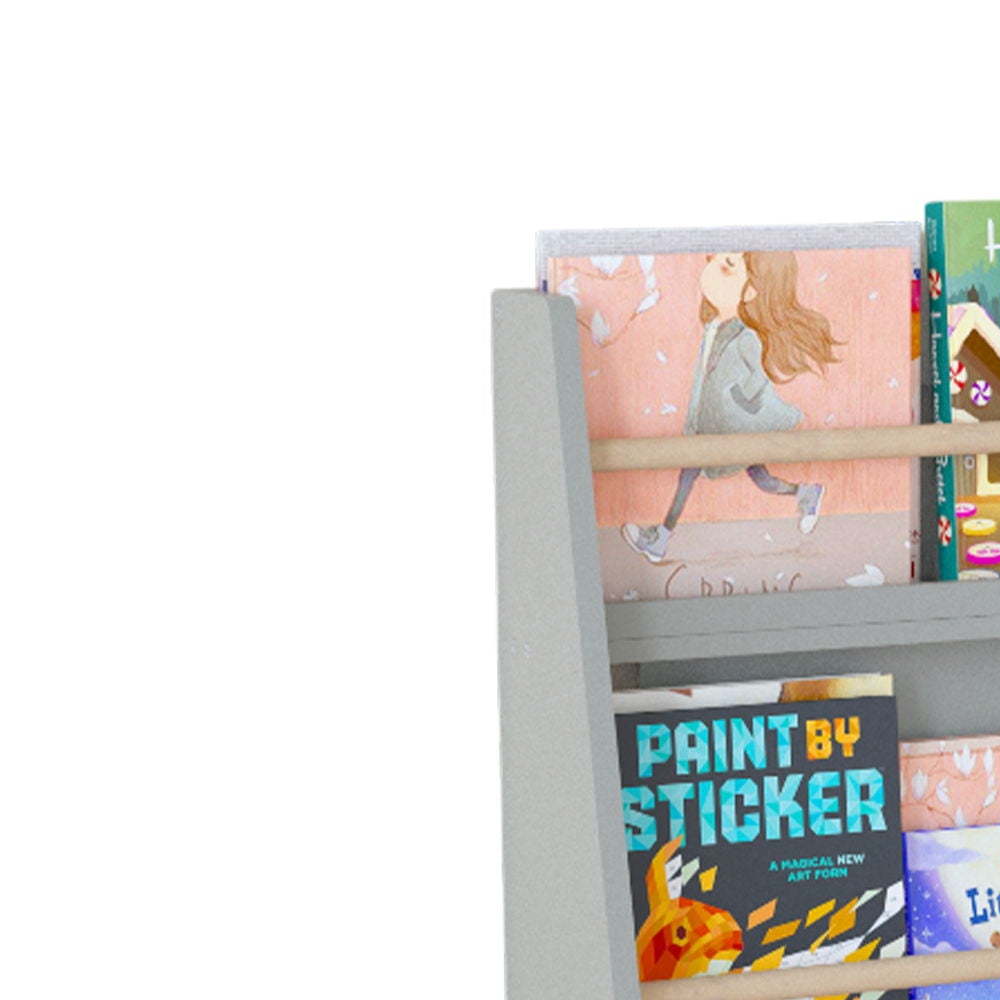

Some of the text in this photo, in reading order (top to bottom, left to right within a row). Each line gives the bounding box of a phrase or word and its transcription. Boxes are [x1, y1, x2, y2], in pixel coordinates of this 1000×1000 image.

[636, 713, 861, 778] PAINT BY
[621, 768, 888, 852] STICKER
[768, 853, 865, 872] A MAGICAL NEW
[787, 866, 849, 882] ART FORM
